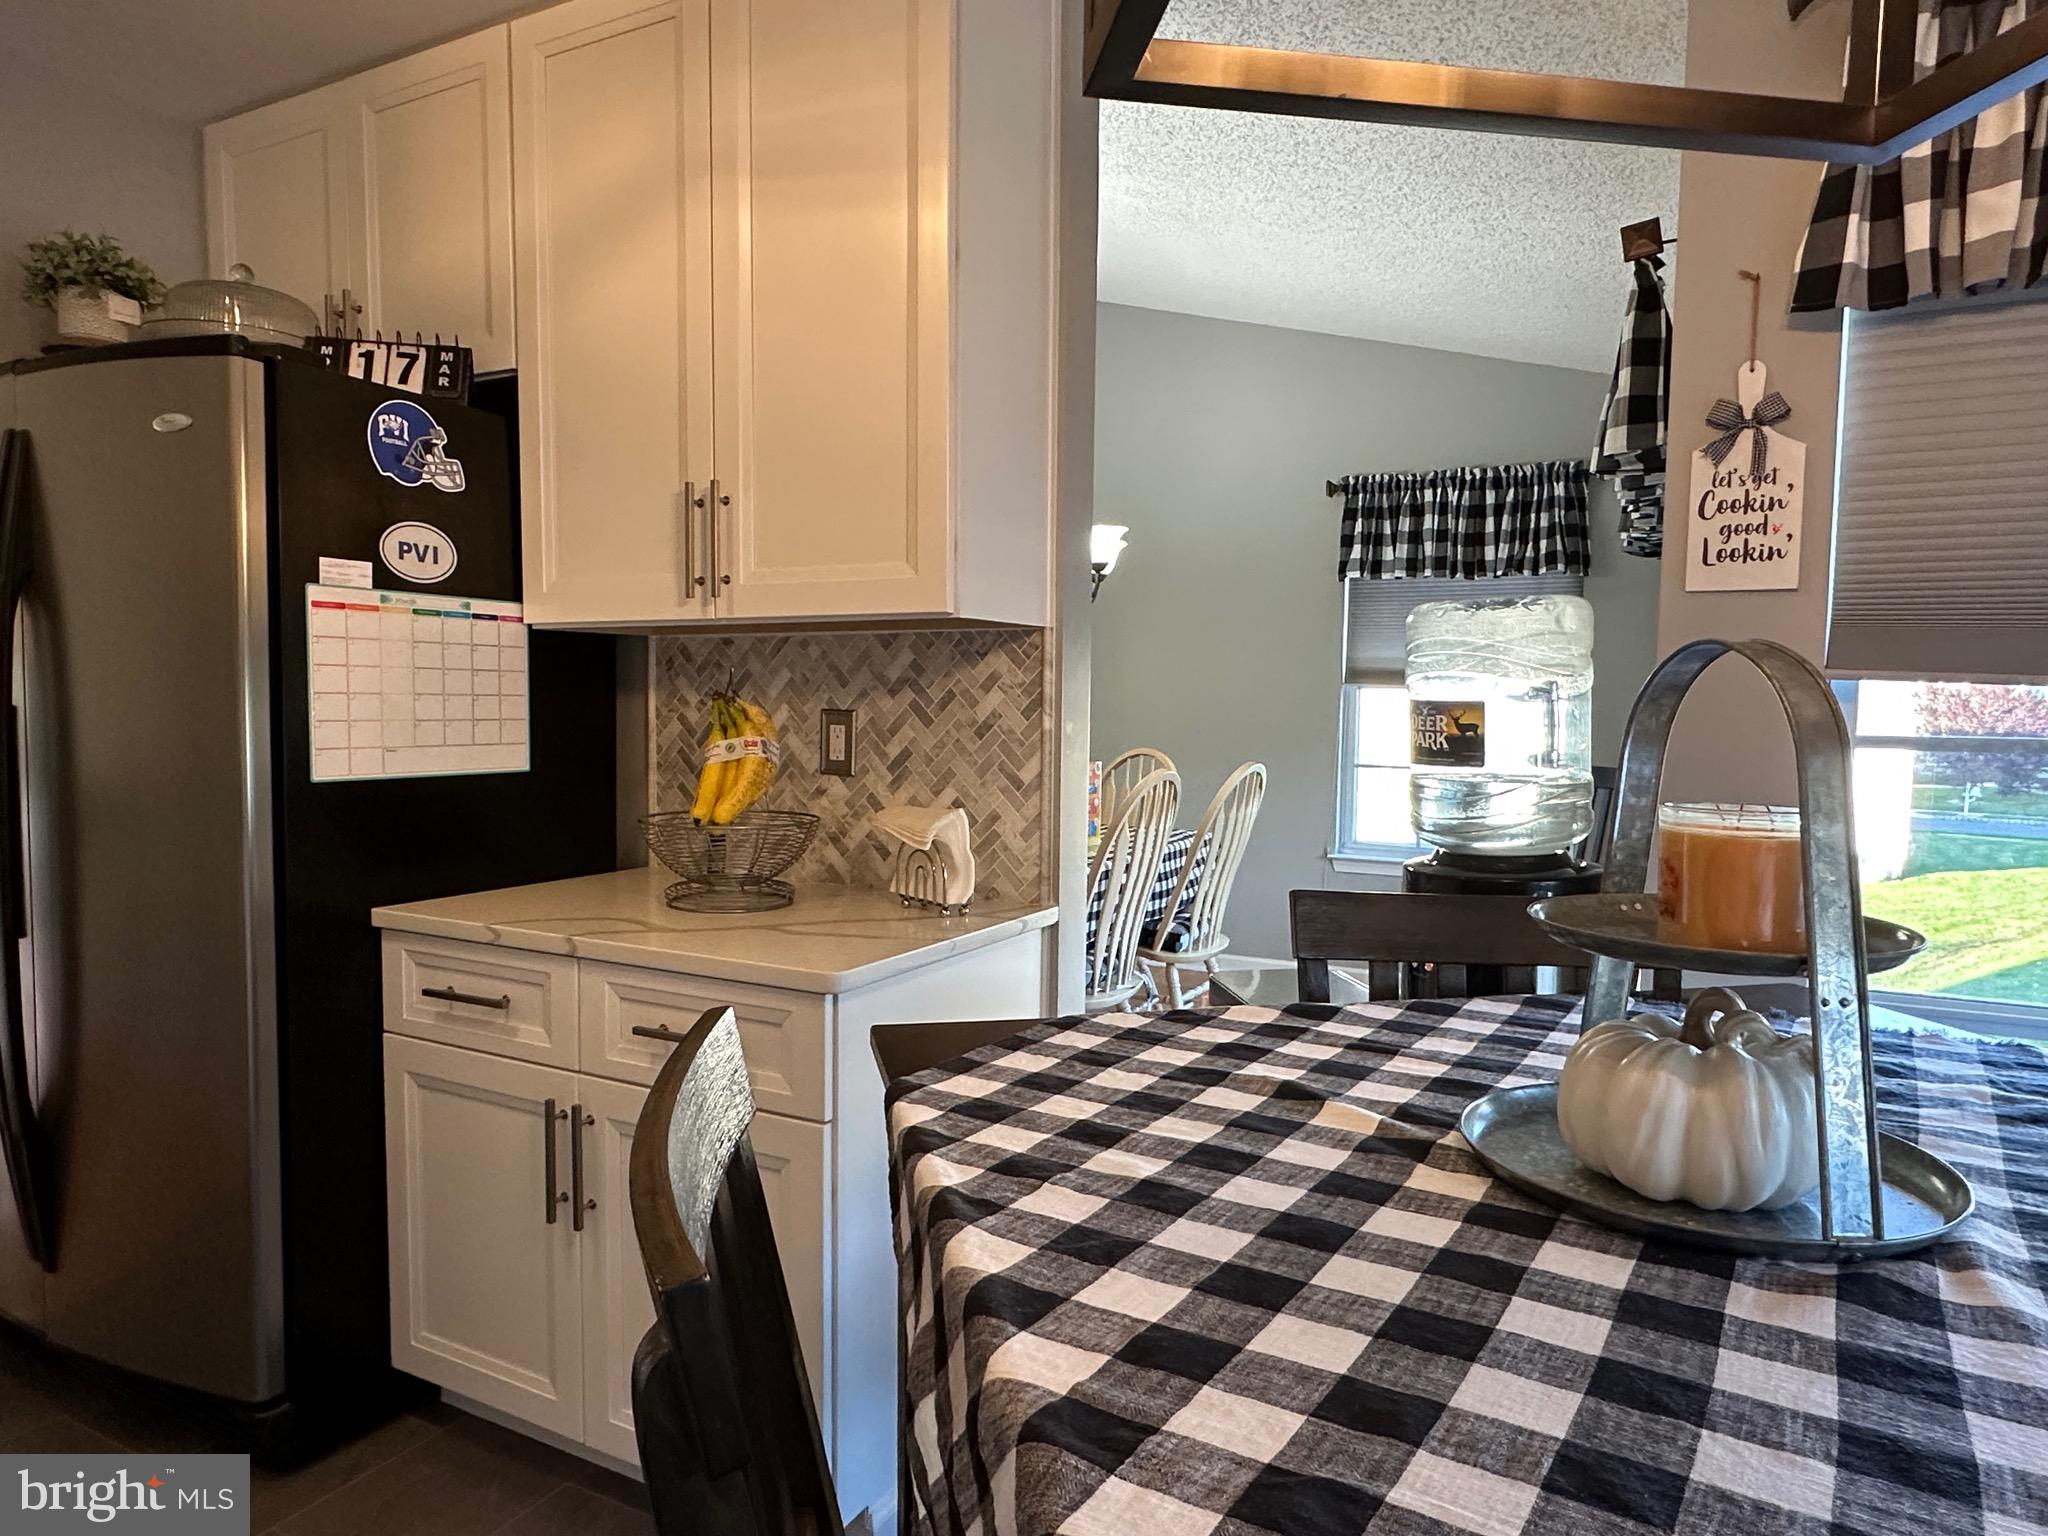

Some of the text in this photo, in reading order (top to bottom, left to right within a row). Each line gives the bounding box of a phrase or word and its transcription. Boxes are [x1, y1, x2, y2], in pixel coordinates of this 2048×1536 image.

[438, 351, 454, 387] MAR
[1711, 467, 1780, 491] let's get
[1719, 513, 1768, 544] good
[398, 541, 439, 565] PVI
[1412, 714, 1448, 732] DEER
[1412, 731, 1449, 750] PARK
